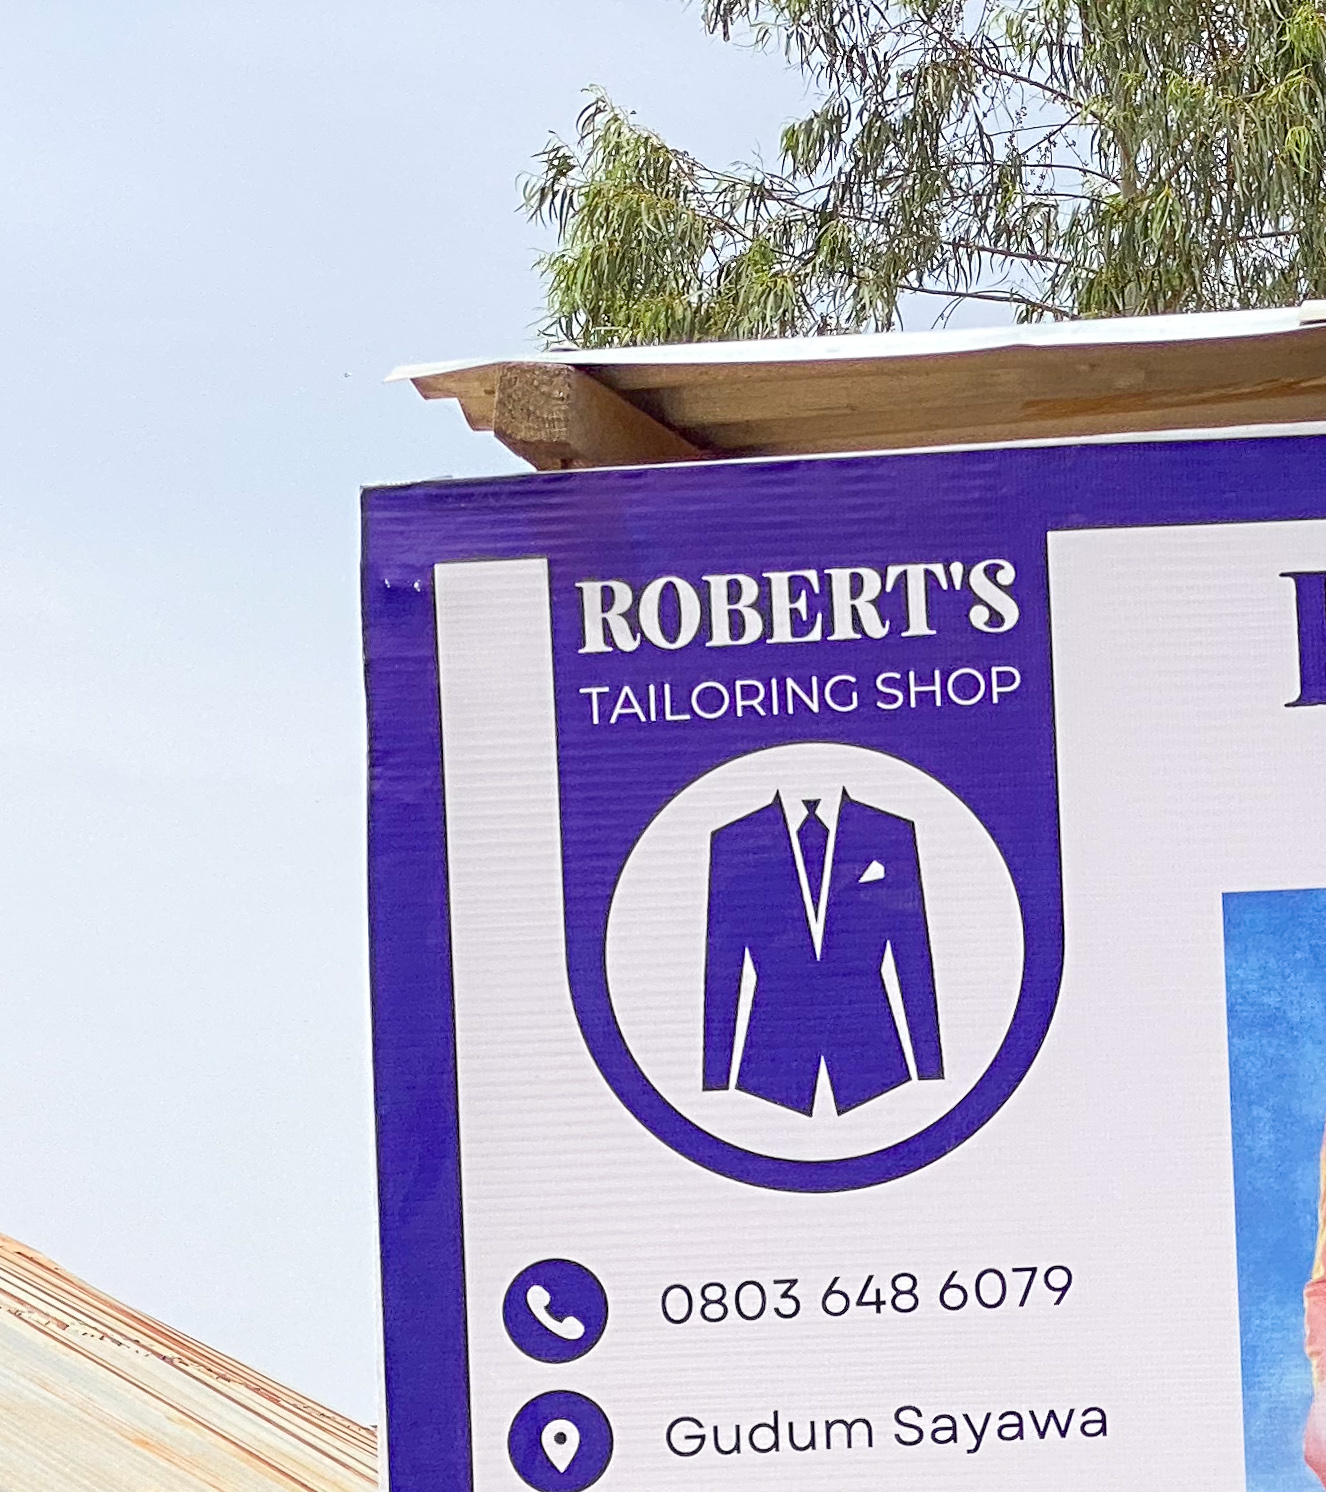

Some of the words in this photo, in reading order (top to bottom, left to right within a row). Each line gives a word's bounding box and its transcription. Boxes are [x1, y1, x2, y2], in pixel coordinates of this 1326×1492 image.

[574, 558, 1020, 654] ROBERT'S
[578, 674, 858, 725] TAILORING
[875, 665, 1021, 710] SHOP
[661, 1278, 801, 1325] 0803
[821, 1272, 919, 1317] 648
[939, 1265, 1073, 1311] 6079
[665, 1410, 873, 1457] Gudum
[894, 1405, 1107, 1455] Sayawa
